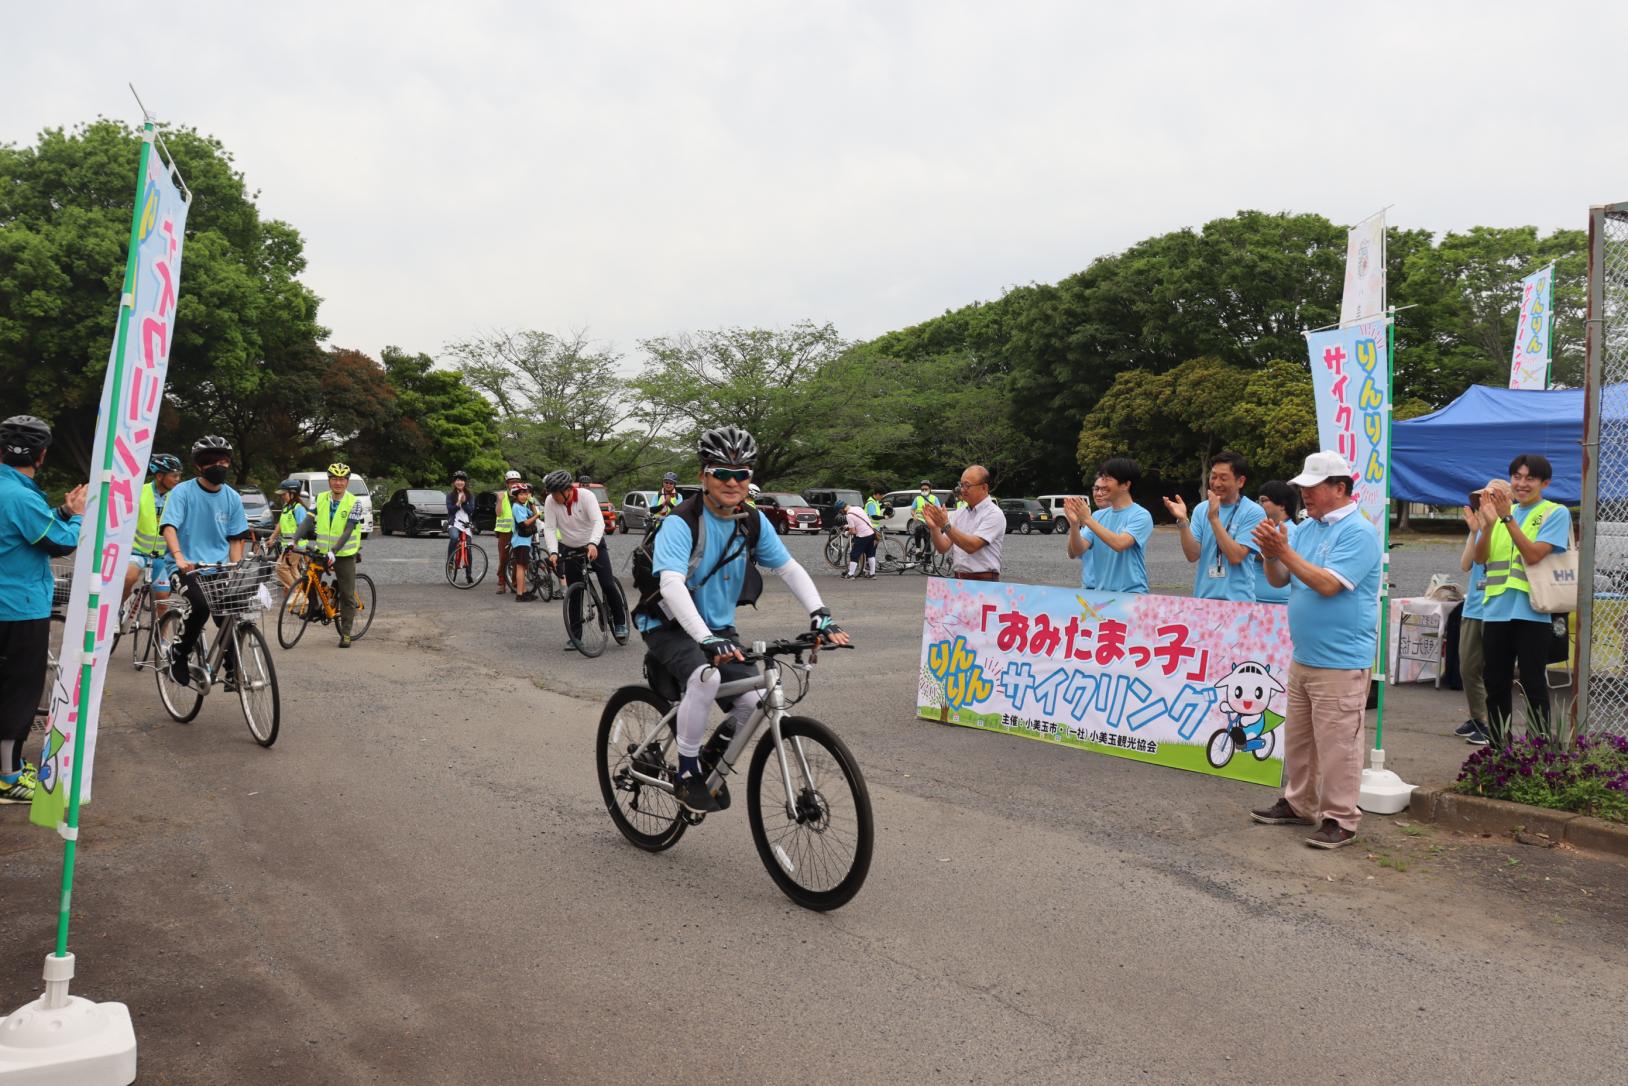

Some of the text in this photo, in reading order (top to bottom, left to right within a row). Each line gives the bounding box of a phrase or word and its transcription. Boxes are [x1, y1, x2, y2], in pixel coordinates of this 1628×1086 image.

[1526, 278, 1545, 354] りんりん
[1324, 346, 1361, 503] サイクリ
[1355, 339, 1384, 484] りんりん
[1552, 569, 1575, 582] HH
[981, 604, 1209, 682] 「おみたまっ子」
[1000, 662, 1218, 741] サイクリング
